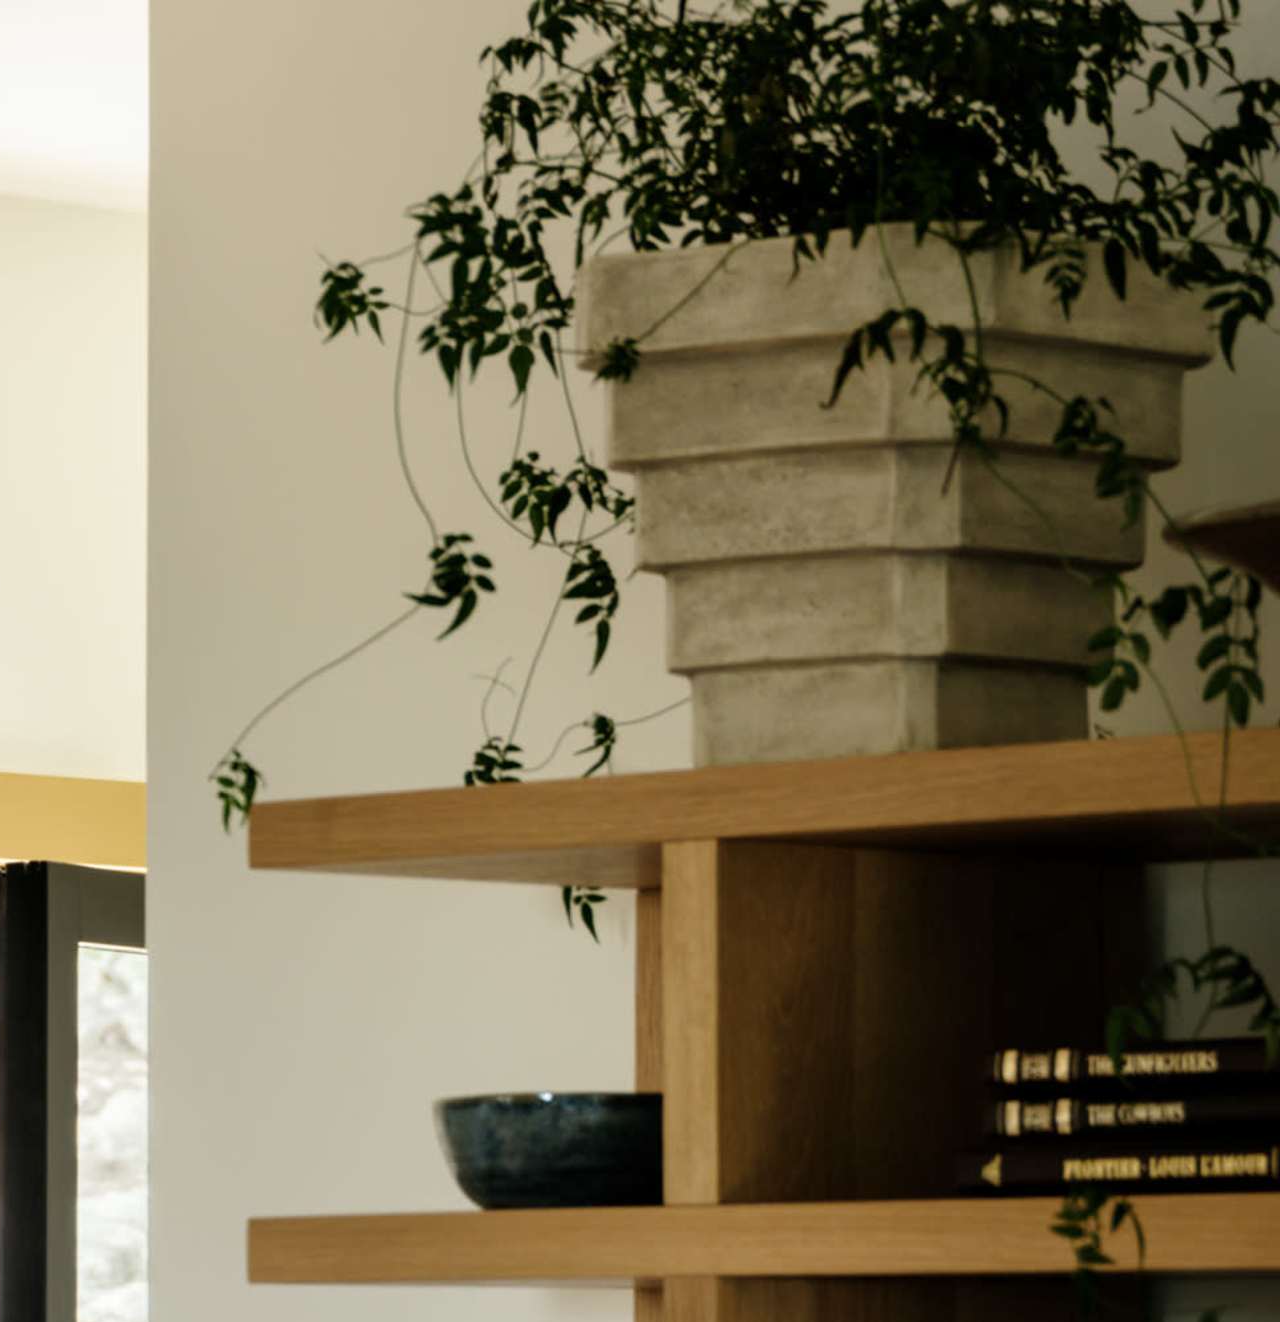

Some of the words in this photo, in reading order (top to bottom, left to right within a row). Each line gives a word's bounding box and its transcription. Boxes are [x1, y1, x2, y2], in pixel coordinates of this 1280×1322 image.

[1088, 1104, 1116, 1126] THE
[1062, 1157, 1141, 1181] FRONTIER
[1148, 1155, 1197, 1178] LOUIS
